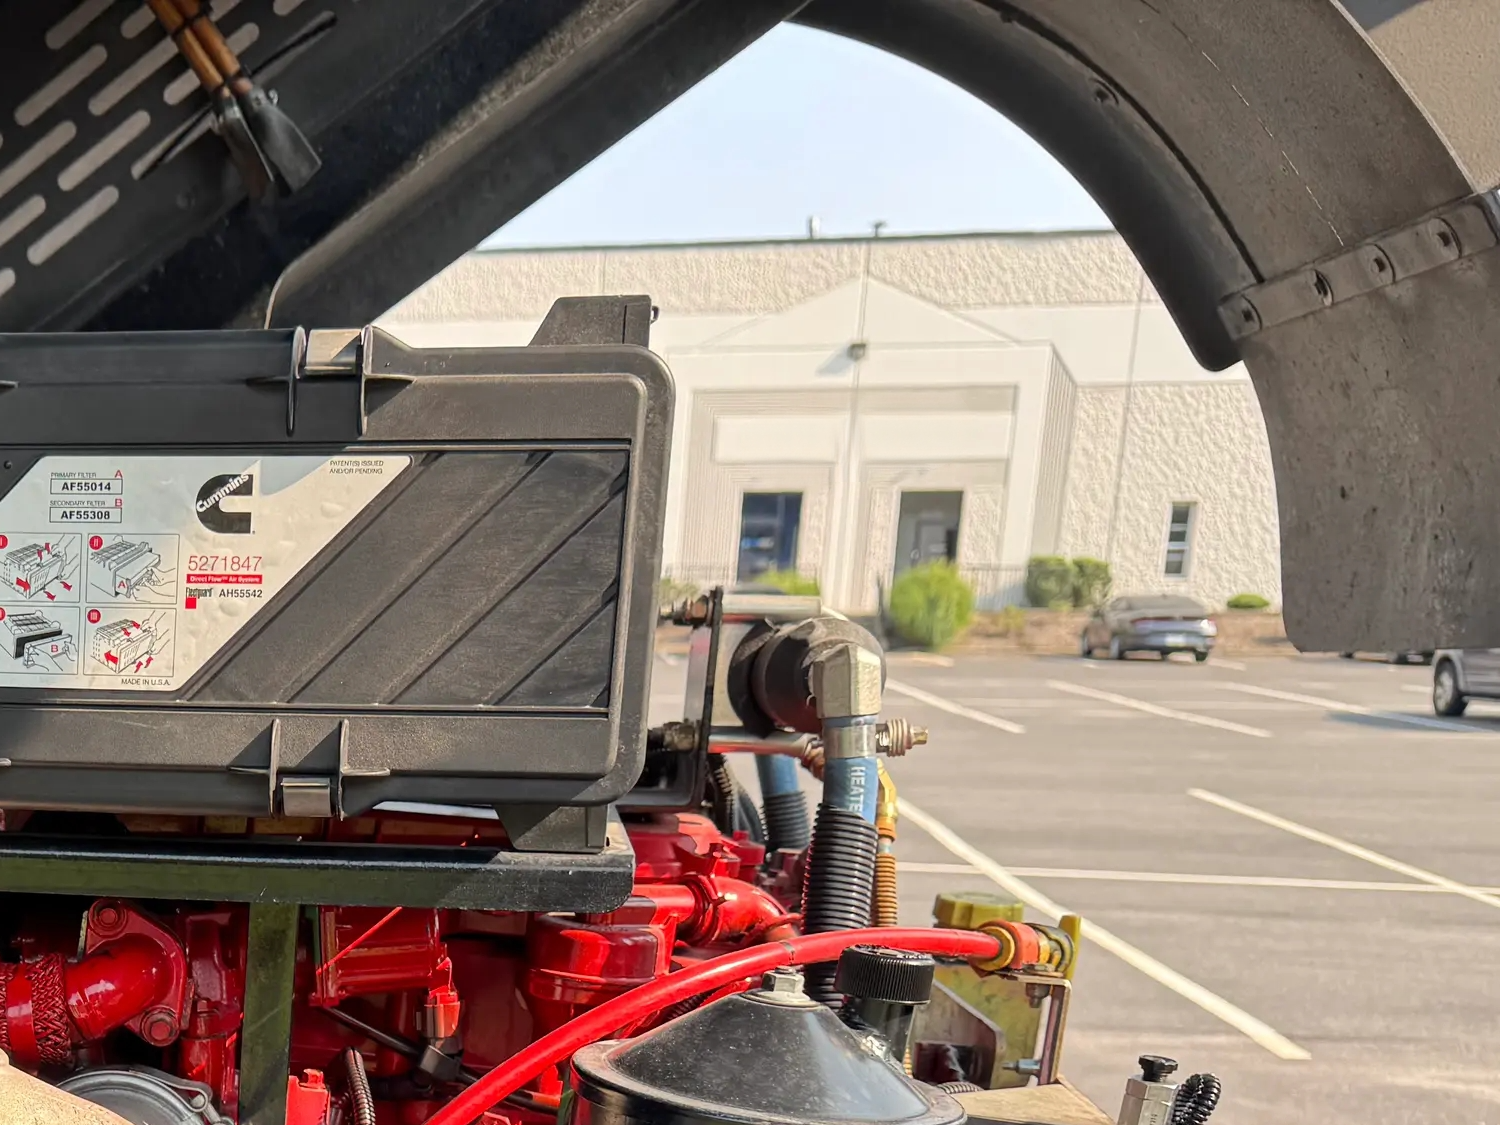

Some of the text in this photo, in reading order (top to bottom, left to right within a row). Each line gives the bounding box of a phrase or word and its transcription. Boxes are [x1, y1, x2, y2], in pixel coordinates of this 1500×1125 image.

[61, 482, 111, 491] AF55014
[196, 474, 250, 513] Cummins
[60, 510, 110, 520] AF55308
[188, 555, 263, 571] 5271847
[238, 576, 260, 584] System
[219, 588, 263, 598] AH55542
[151, 678, 171, 686] U.S.A.
